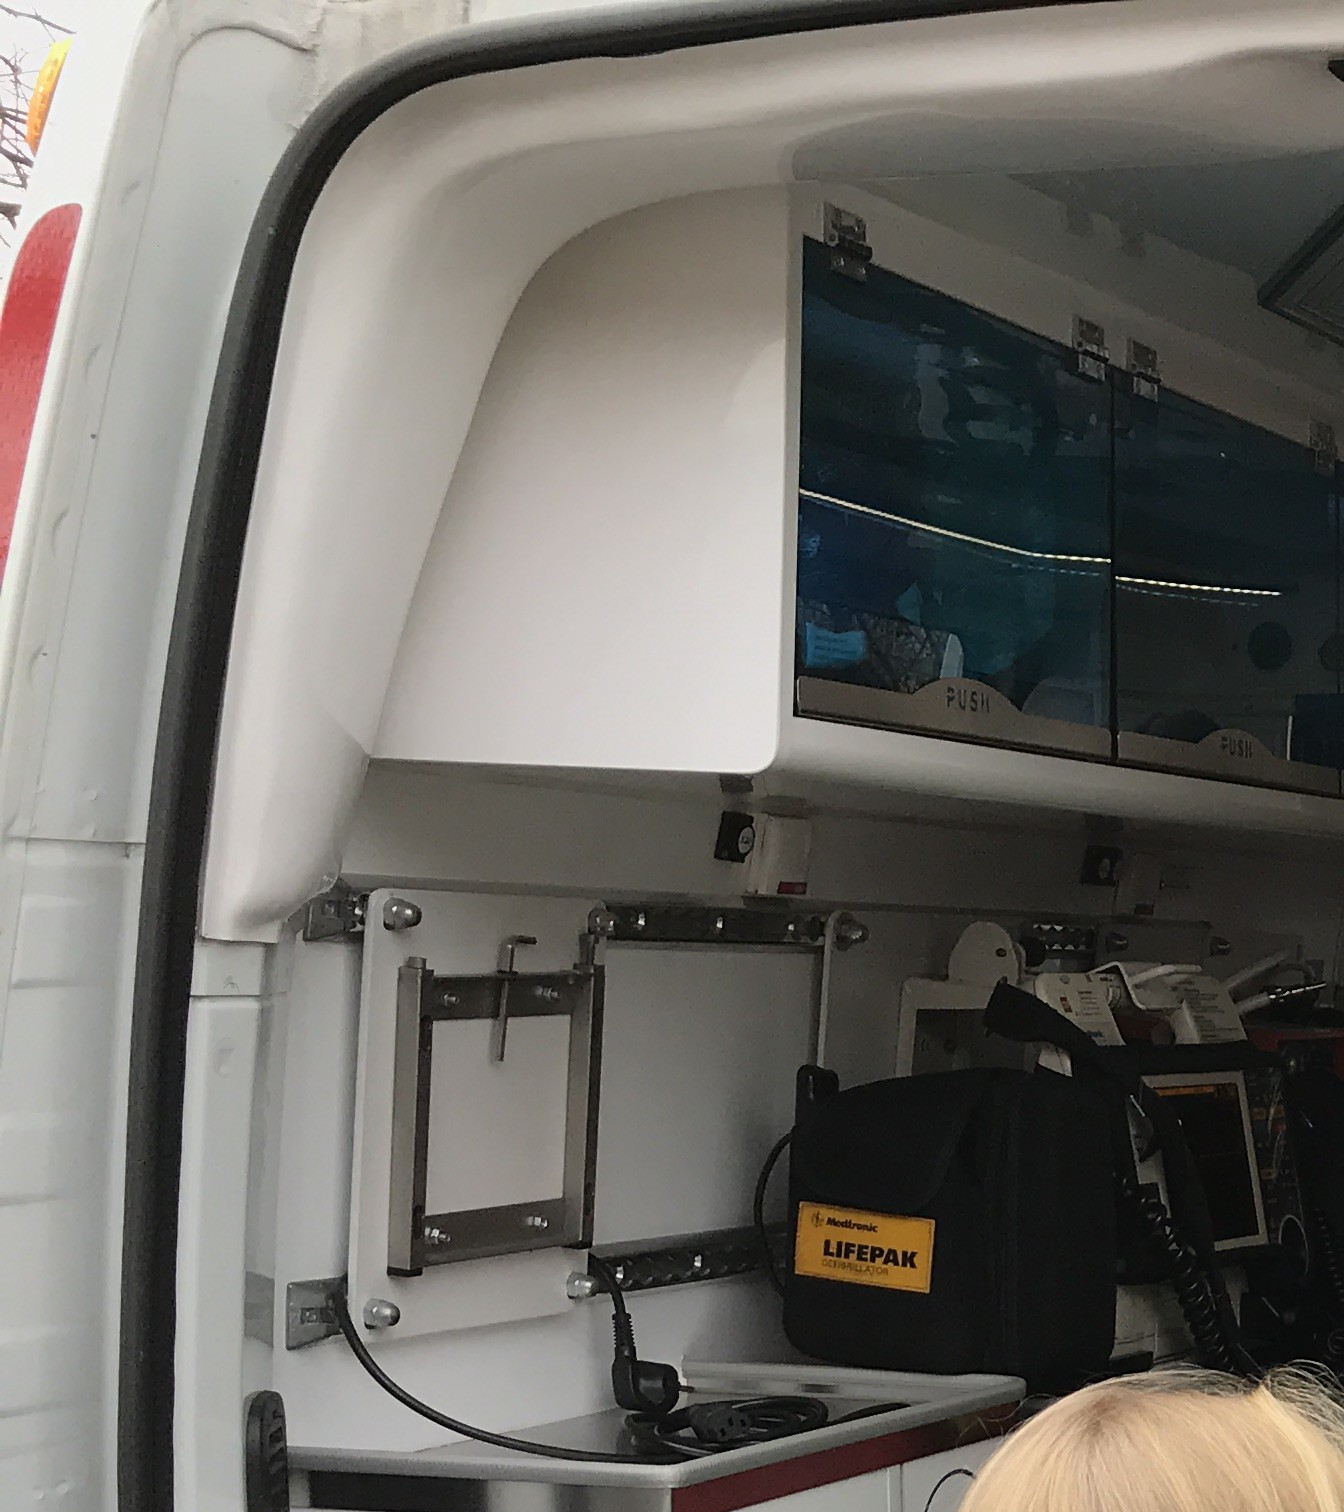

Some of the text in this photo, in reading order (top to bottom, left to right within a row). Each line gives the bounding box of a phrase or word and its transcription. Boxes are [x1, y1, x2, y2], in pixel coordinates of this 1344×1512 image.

[946, 686, 990, 713] PUSH
[825, 1216, 879, 1233] Medtronic
[823, 1238, 918, 1269] LIFEPAK
